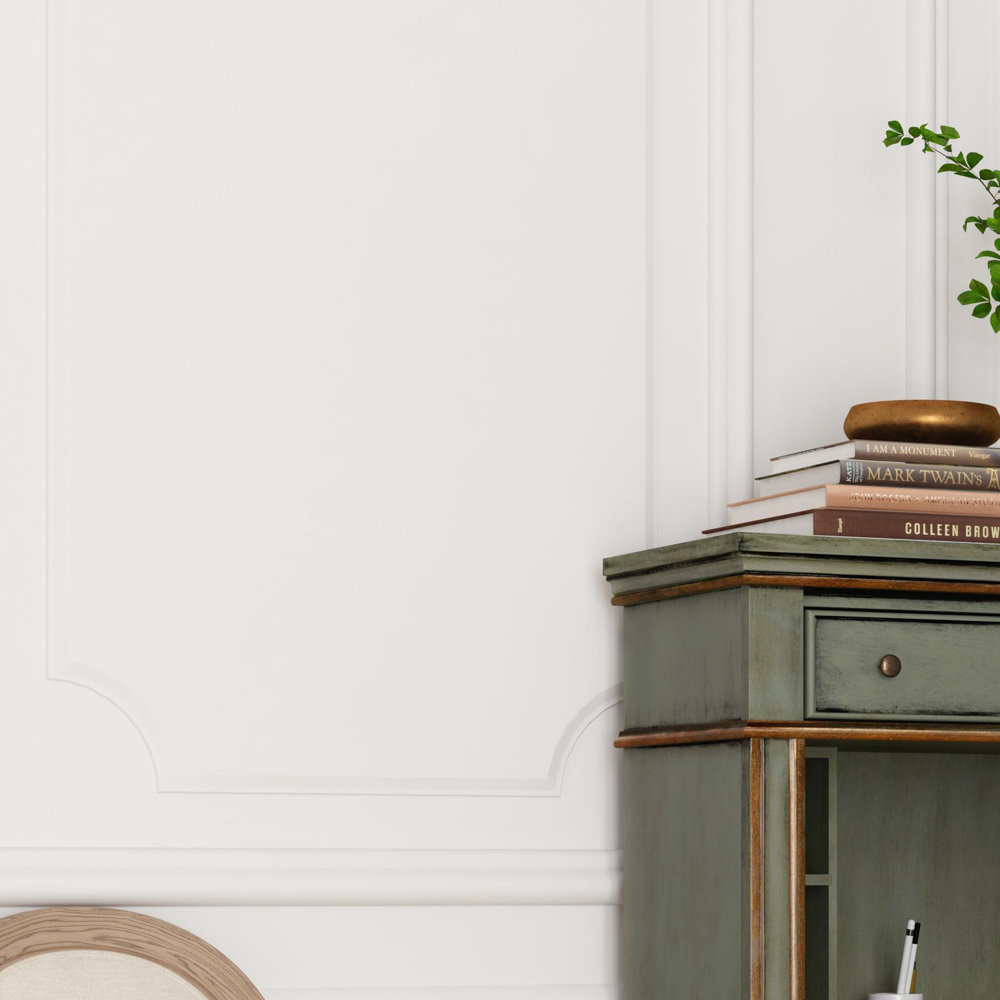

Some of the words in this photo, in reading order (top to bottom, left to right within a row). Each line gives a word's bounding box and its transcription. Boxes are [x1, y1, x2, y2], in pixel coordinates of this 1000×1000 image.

[866, 444, 870, 453] I
[872, 444, 888, 454] AM
[890, 445, 898, 454] A
[900, 446, 957, 457] MONUMENT
[867, 466, 915, 483] MARK
[905, 522, 959, 537] COLLEEN
